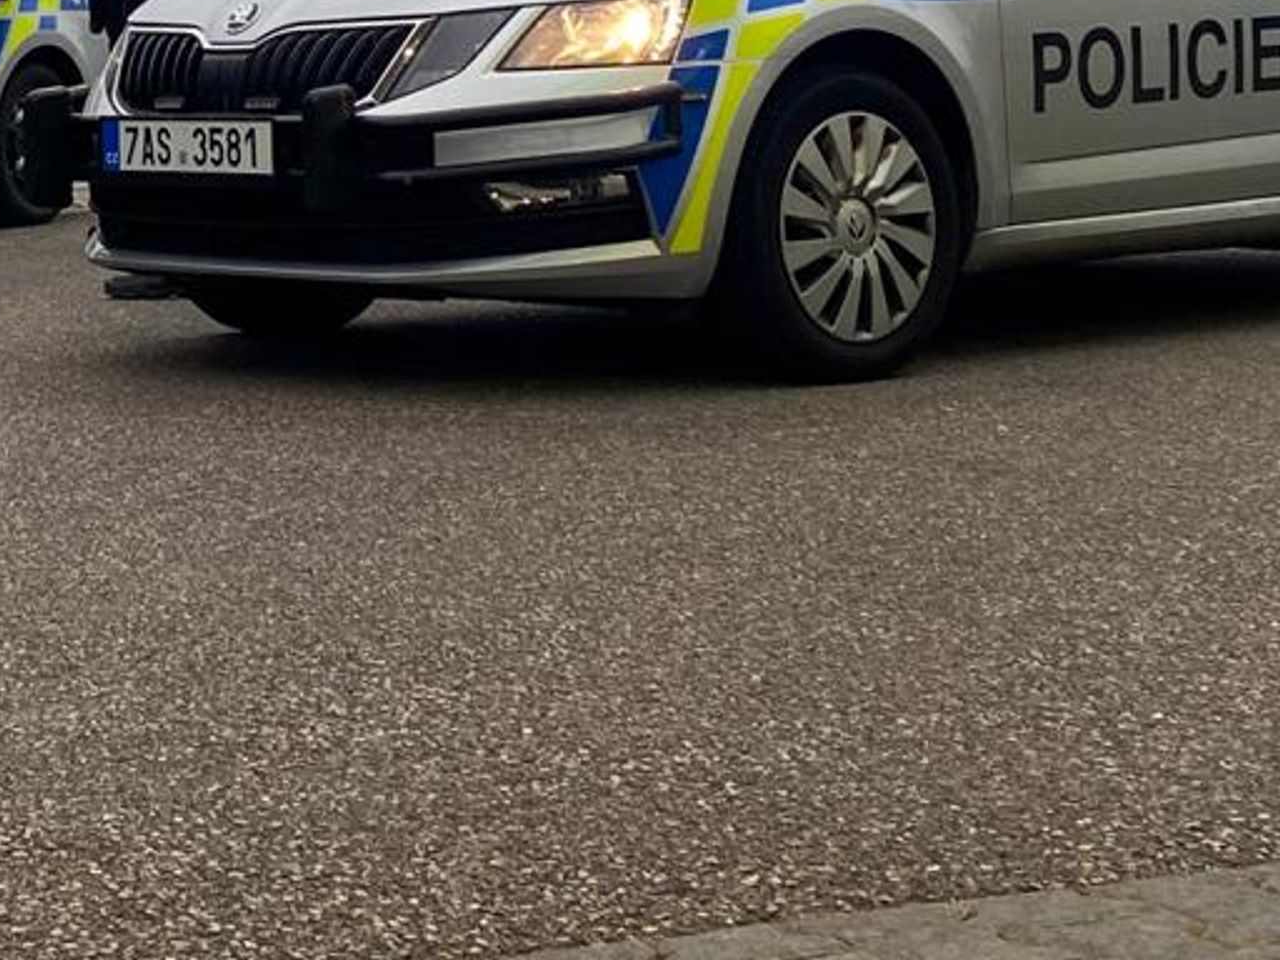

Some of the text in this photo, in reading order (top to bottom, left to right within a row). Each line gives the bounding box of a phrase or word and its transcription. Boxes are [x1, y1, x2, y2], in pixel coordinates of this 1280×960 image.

[1032, 15, 1280, 113] POLICIE
[125, 127, 257, 168] 7AS 3581
